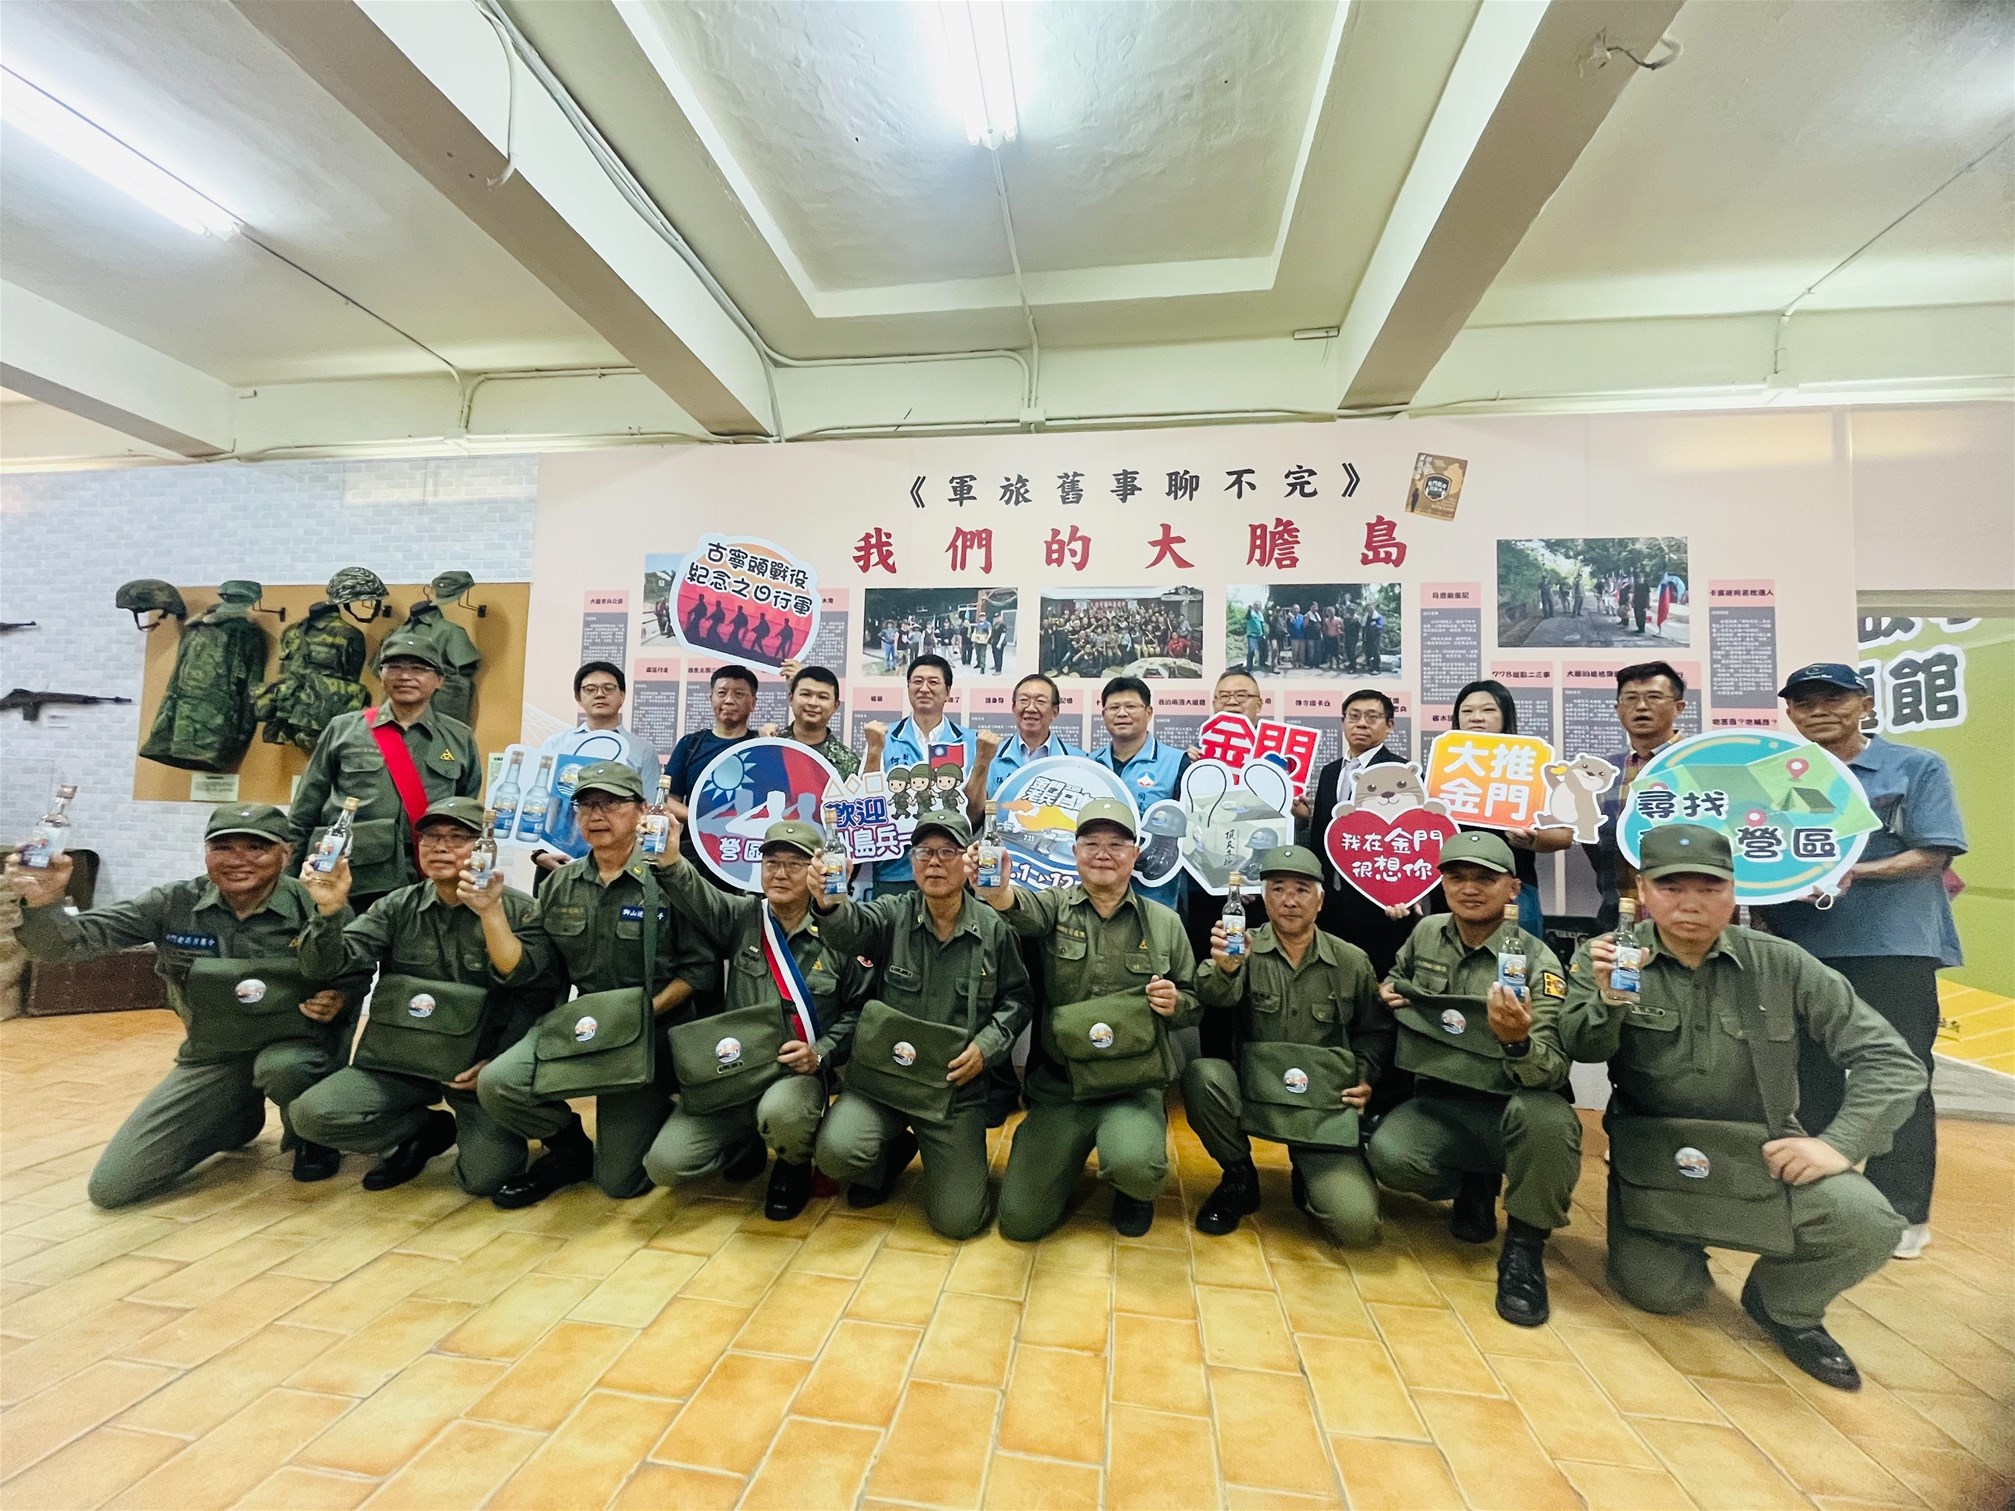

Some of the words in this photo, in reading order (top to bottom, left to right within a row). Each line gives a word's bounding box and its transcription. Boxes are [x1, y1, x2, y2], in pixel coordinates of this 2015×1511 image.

[909, 462, 1361, 509] 《軍旅舊事聊不完》
[707, 542, 809, 590] 古寧頭戰役
[852, 515, 1408, 575] 我們的大膽島
[686, 561, 813, 615] 紀念之日行軍
[1202, 713, 1320, 785] 金門
[1443, 740, 1537, 781] 大推
[824, 798, 887, 828] 歡迎
[1439, 778, 1530, 821] 金門
[1637, 790, 1725, 818] 尋找
[1341, 829, 1443, 855] 我在金門
[1737, 826, 1837, 859] 營區
[1351, 857, 1434, 882] 很想你
